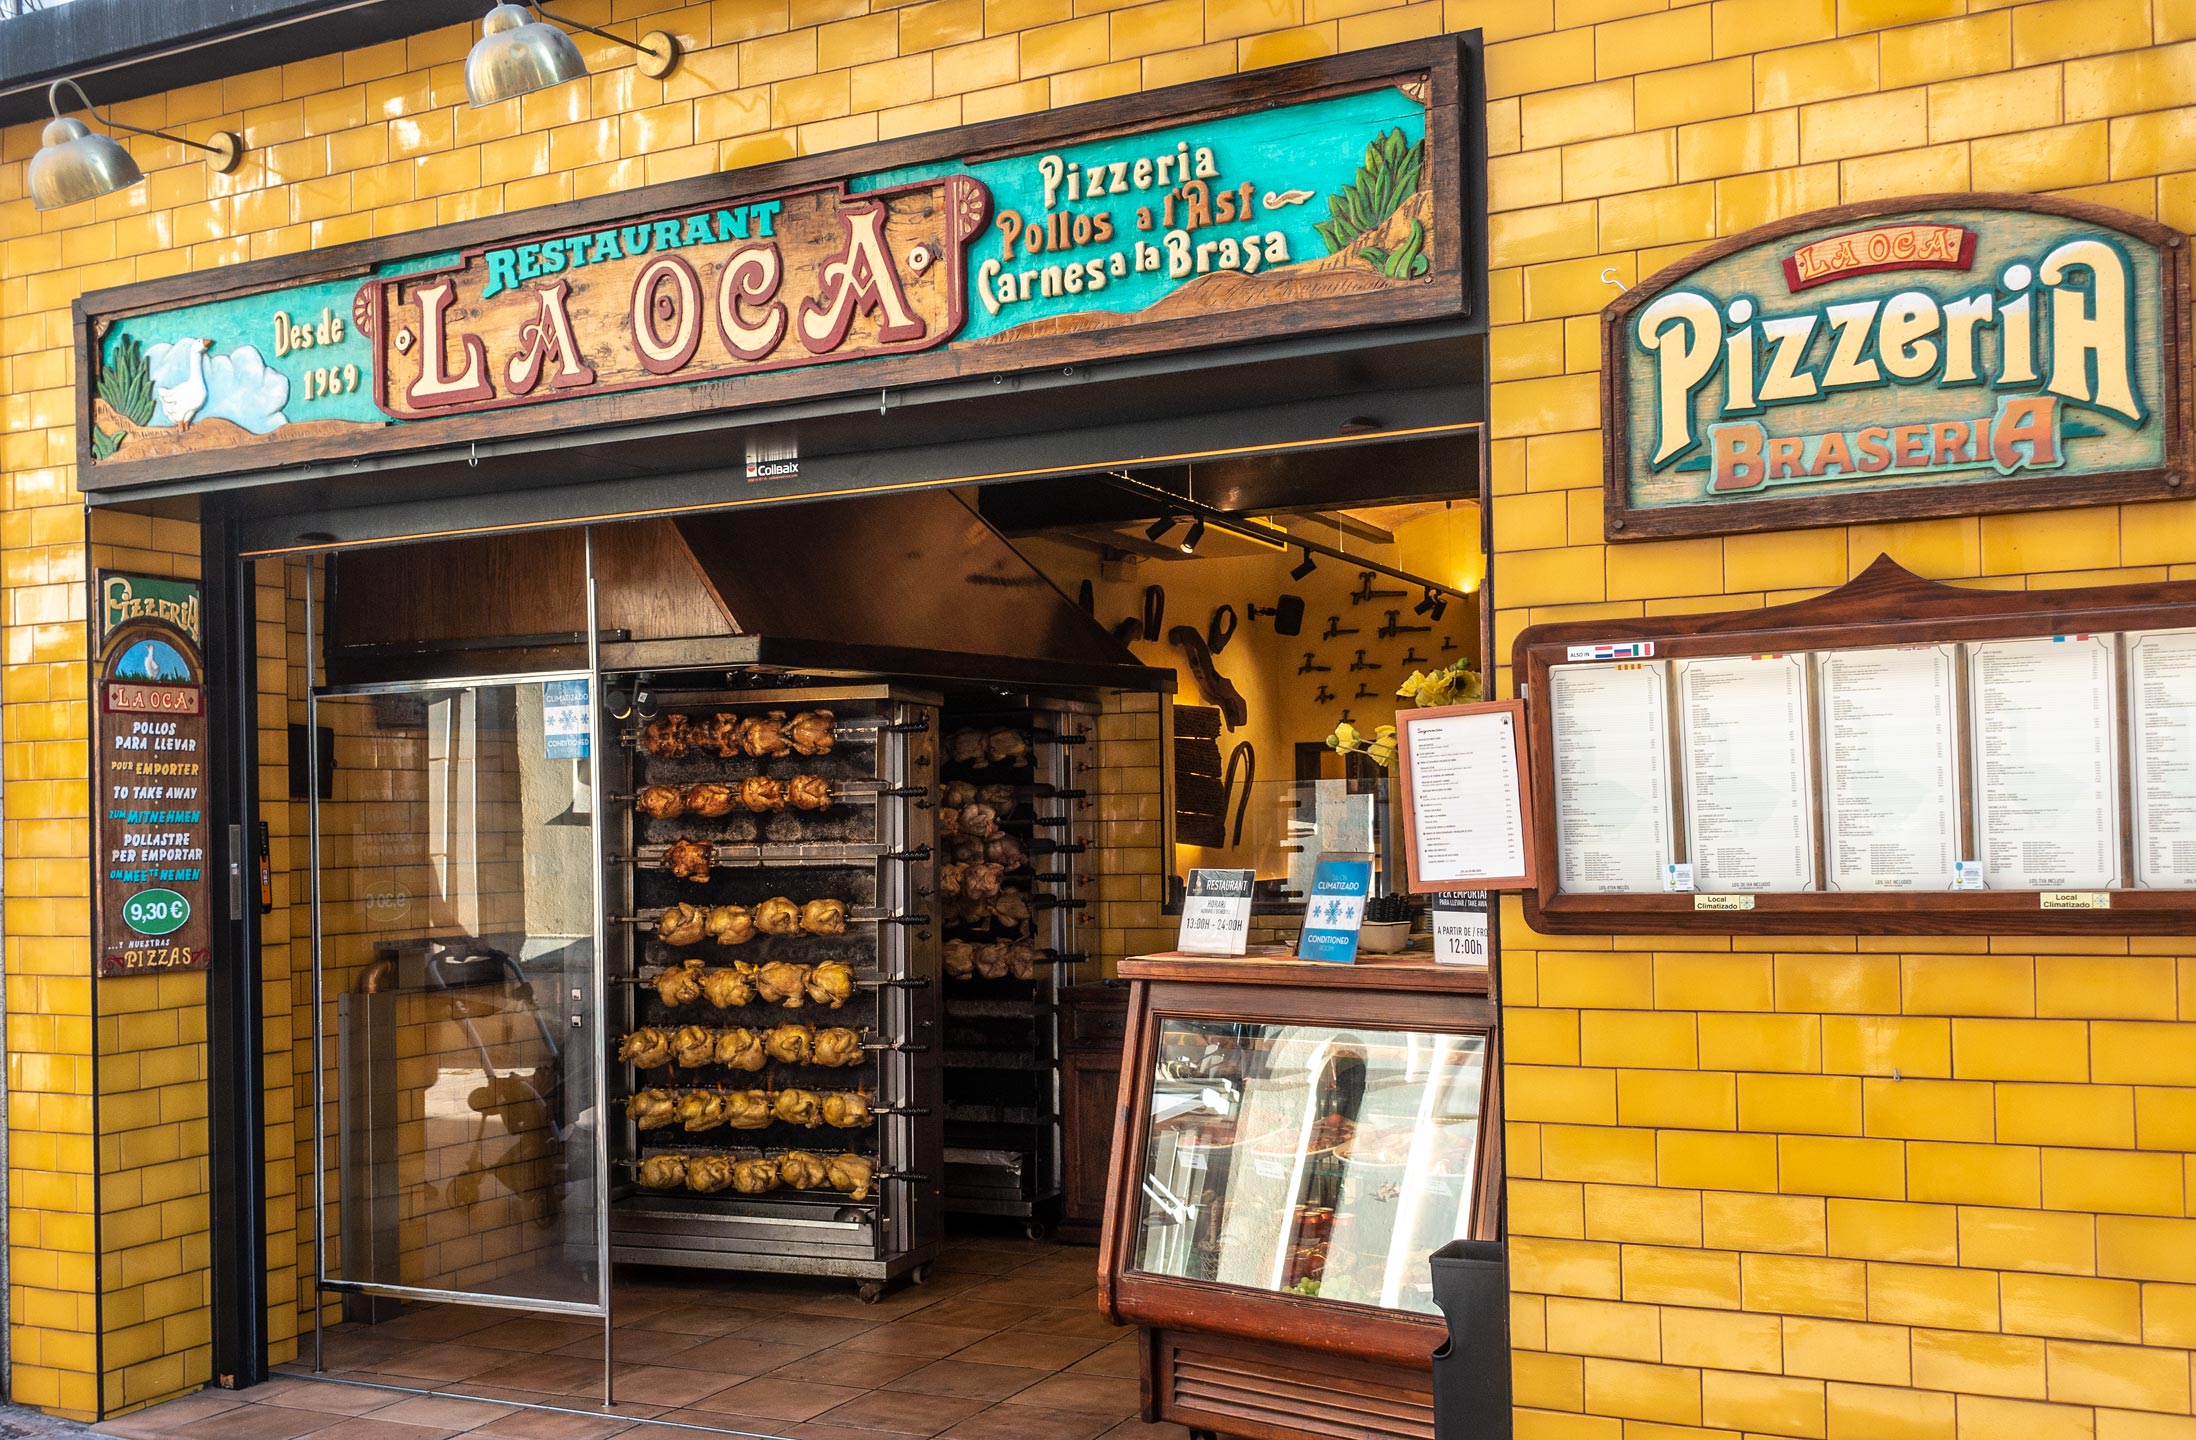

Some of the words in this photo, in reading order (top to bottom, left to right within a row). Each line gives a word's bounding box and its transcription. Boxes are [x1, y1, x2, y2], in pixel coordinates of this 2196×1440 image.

[1038, 141, 1221, 209] Pizzeria
[995, 209, 1115, 261] Pollos
[1136, 205, 1151, 232] a
[1163, 180, 1256, 230] l'Ast
[483, 199, 781, 299] RESTAURANT
[1800, 246, 1856, 280] LA
[1868, 226, 1957, 263] OCA
[977, 256, 1108, 316] Carnes
[1109, 252, 1126, 278] a
[1134, 241, 1161, 272] la
[1162, 229, 1290, 278] Brasa
[408, 276, 595, 410] LA
[630, 203, 926, 376] OCA
[274, 308, 345, 357] Desde
[304, 364, 359, 400] 1969
[1712, 396, 2063, 491] BRASERIA
[117, 687, 145, 709] LA
[150, 691, 190, 711] OCA
[546, 693, 589, 703] CLIMATIZADO
[133, 721, 177, 736] POLLOS
[115, 736, 148, 751] PARA
[154, 737, 197, 752] LLEVAR
[111, 761, 133, 771] POUR
[136, 762, 199, 776] EMPORTER
[113, 785, 129, 799] TO
[133, 786, 164, 799] TAKE
[166, 786, 198, 800] AWAY
[109, 809, 127, 820] ZUM
[127, 810, 200, 824] MITNEHMEN
[124, 833, 190, 847] POLLASTRE
[112, 850, 137, 863] PER
[141, 848, 203, 862] EMPORTAR
[110, 869, 123, 880] OM
[123, 870, 147, 883] MEE
[149, 868, 159, 878] TE
[159, 869, 201, 882] NEMEN
[1206, 880, 1248, 891] RESTAURANT
[1318, 882, 1360, 890] CLIMATIZADO
[130, 902, 167, 924] 9,30
[169, 901, 183, 919] €
[2043, 901, 2090, 909] Climatizado
[1186, 918, 1210, 929] 13:00H
[1217, 919, 1243, 931] 24:00H
[1437, 926, 1442, 934] A
[1443, 926, 1462, 936] PARTIR
[1464, 927, 1471, 936] DE
[1476, 928, 1488, 937] FRO
[128, 938, 171, 949] NUESTRAS
[1308, 935, 1349, 945] CONDITIONED
[1449, 938, 1483, 955] 12:00h
[124, 947, 192, 968] PIZZAS
